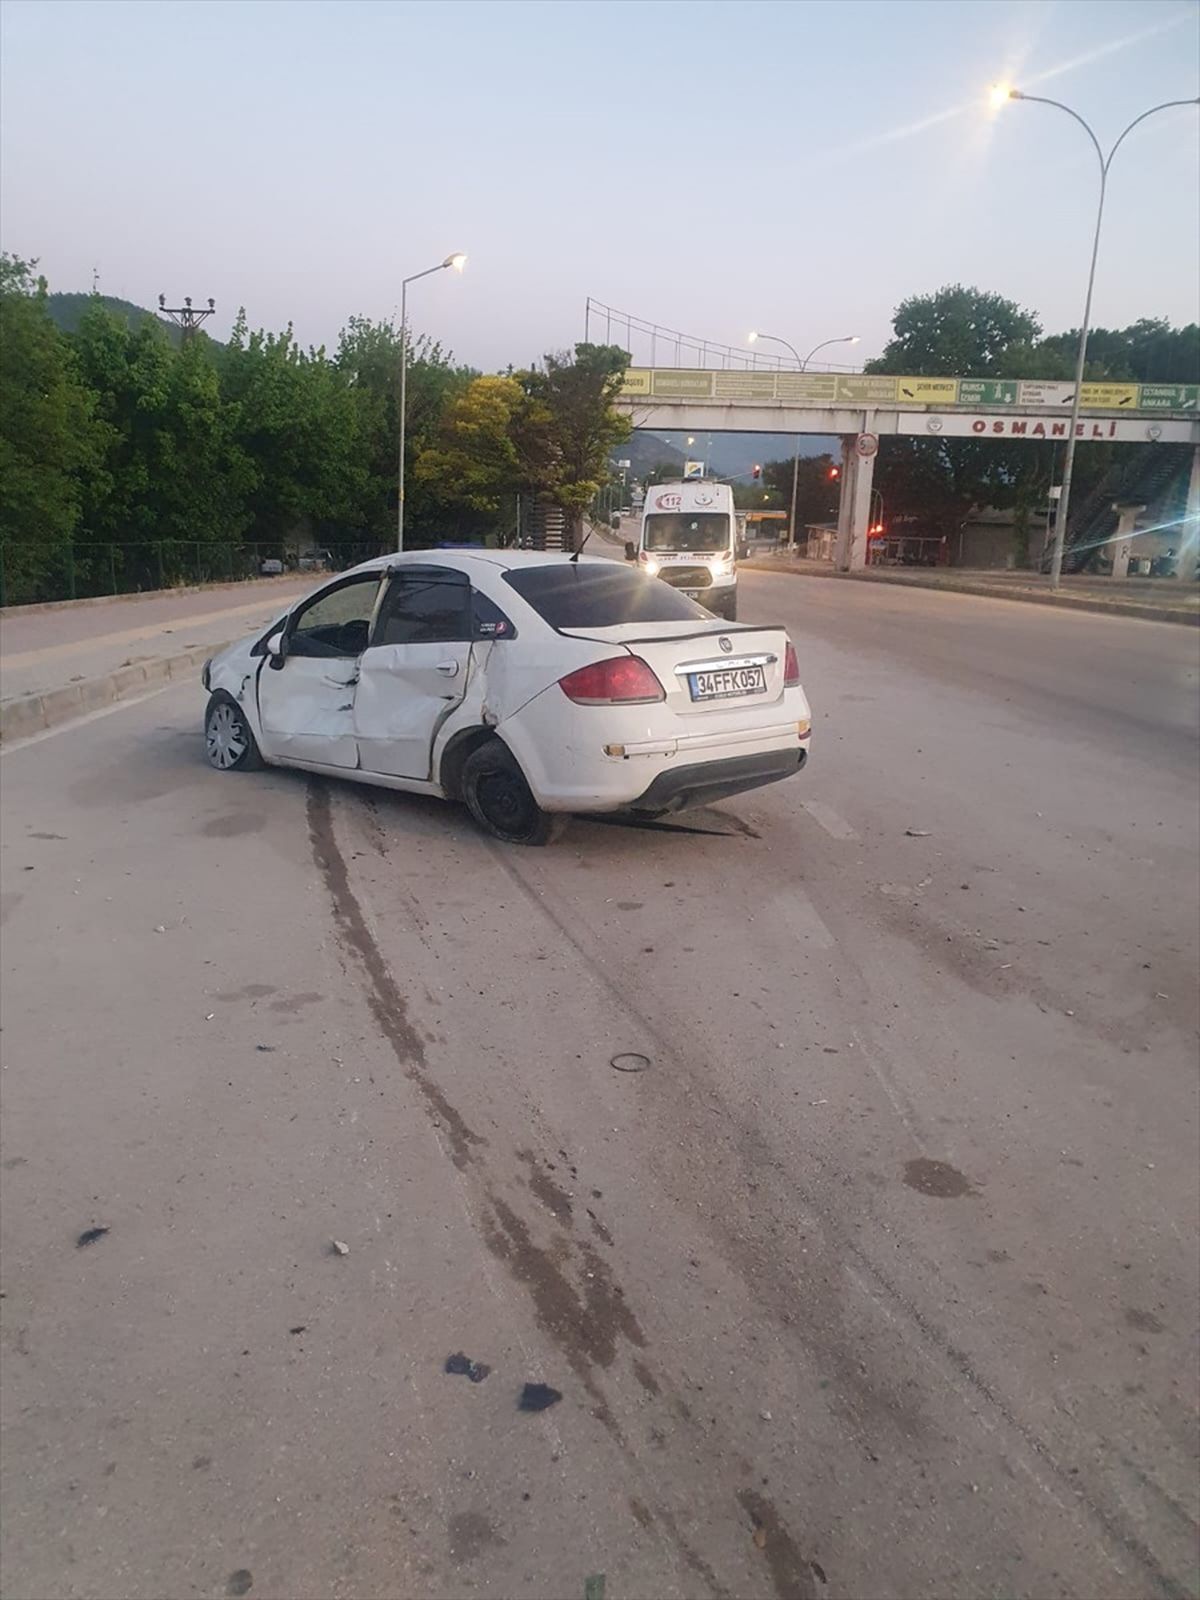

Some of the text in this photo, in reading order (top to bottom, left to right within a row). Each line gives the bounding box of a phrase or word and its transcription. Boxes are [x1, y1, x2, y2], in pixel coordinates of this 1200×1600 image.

[961, 383, 985, 392] BURSA
[1142, 399, 1171, 407] ANKARA
[972, 420, 1116, 437] OSMANELİ
[665, 497, 681, 506] 112
